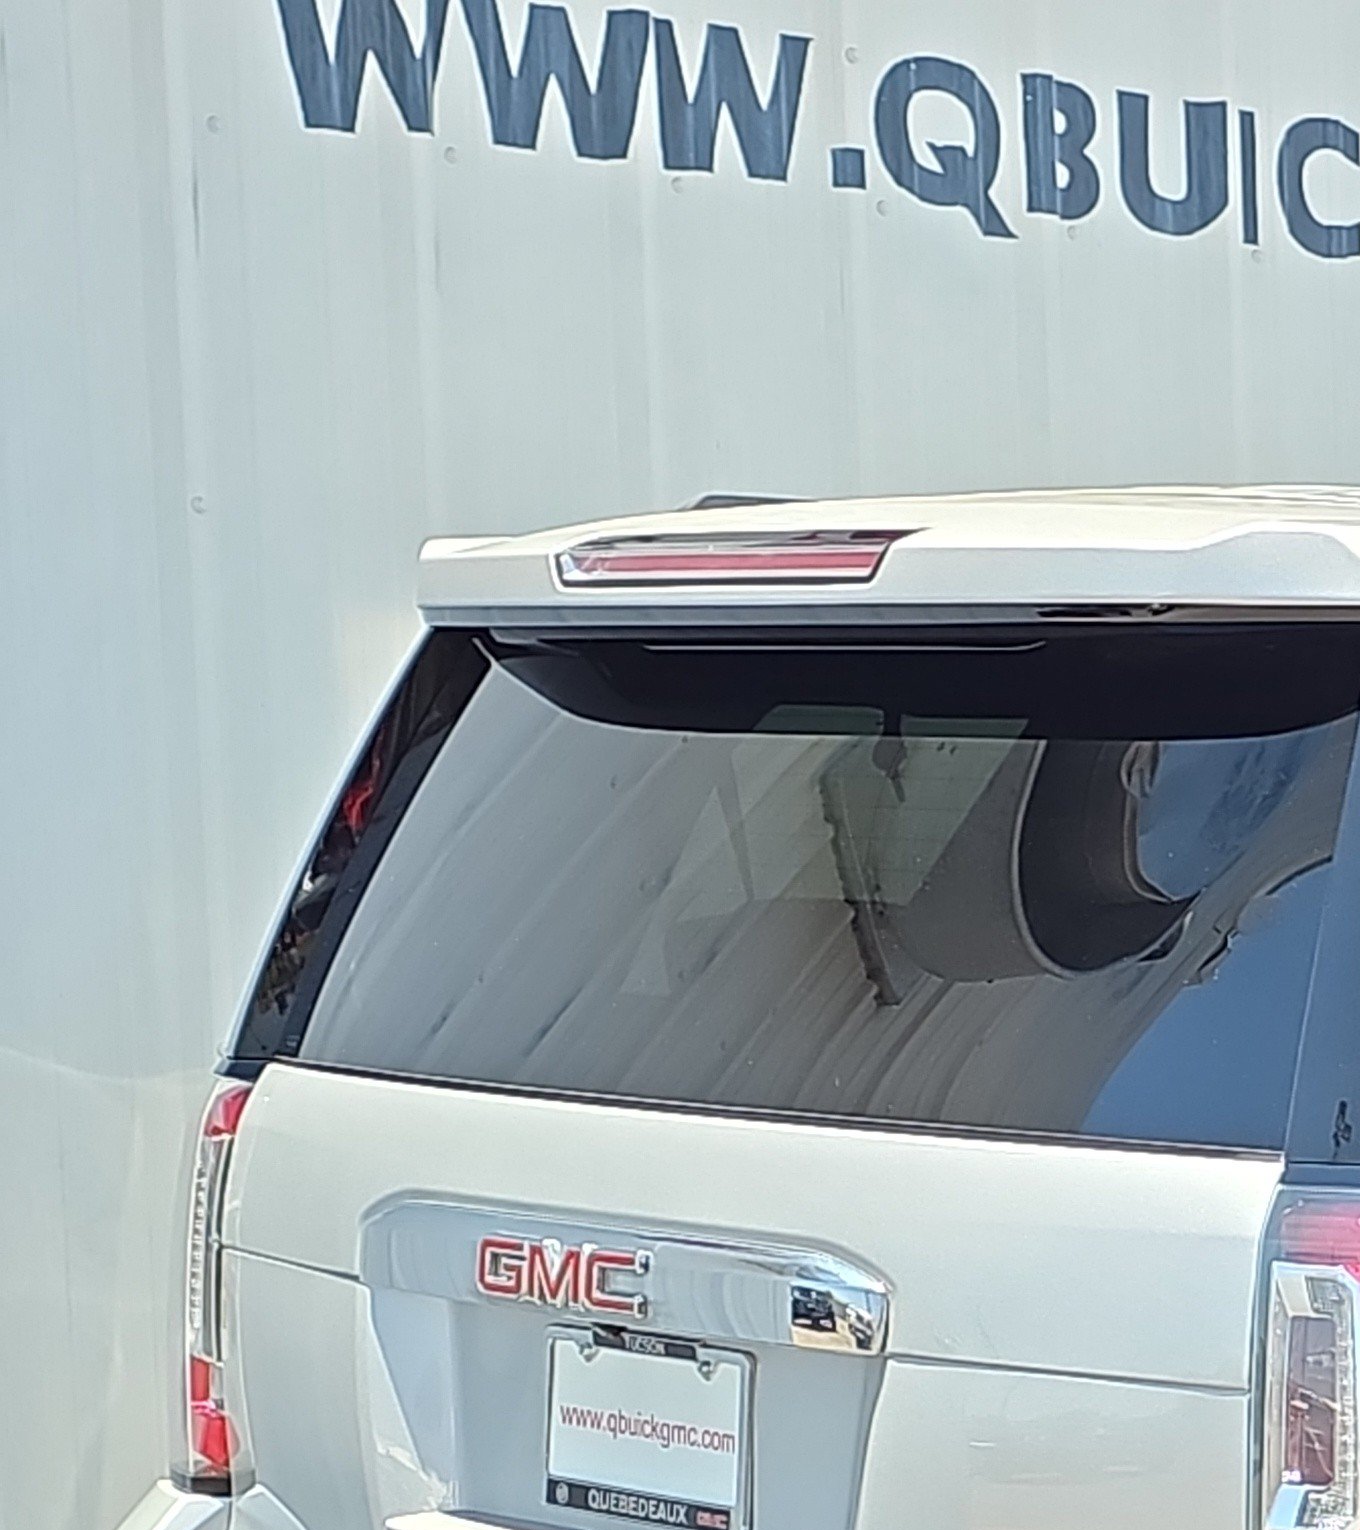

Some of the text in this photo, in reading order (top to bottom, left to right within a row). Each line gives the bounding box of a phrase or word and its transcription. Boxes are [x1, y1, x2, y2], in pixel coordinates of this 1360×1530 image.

[476, 1234, 652, 1319] GMC
[559, 1404, 737, 1454] www.qbuickgmc.com
[587, 1489, 689, 1526] QUEBEDEAUX
